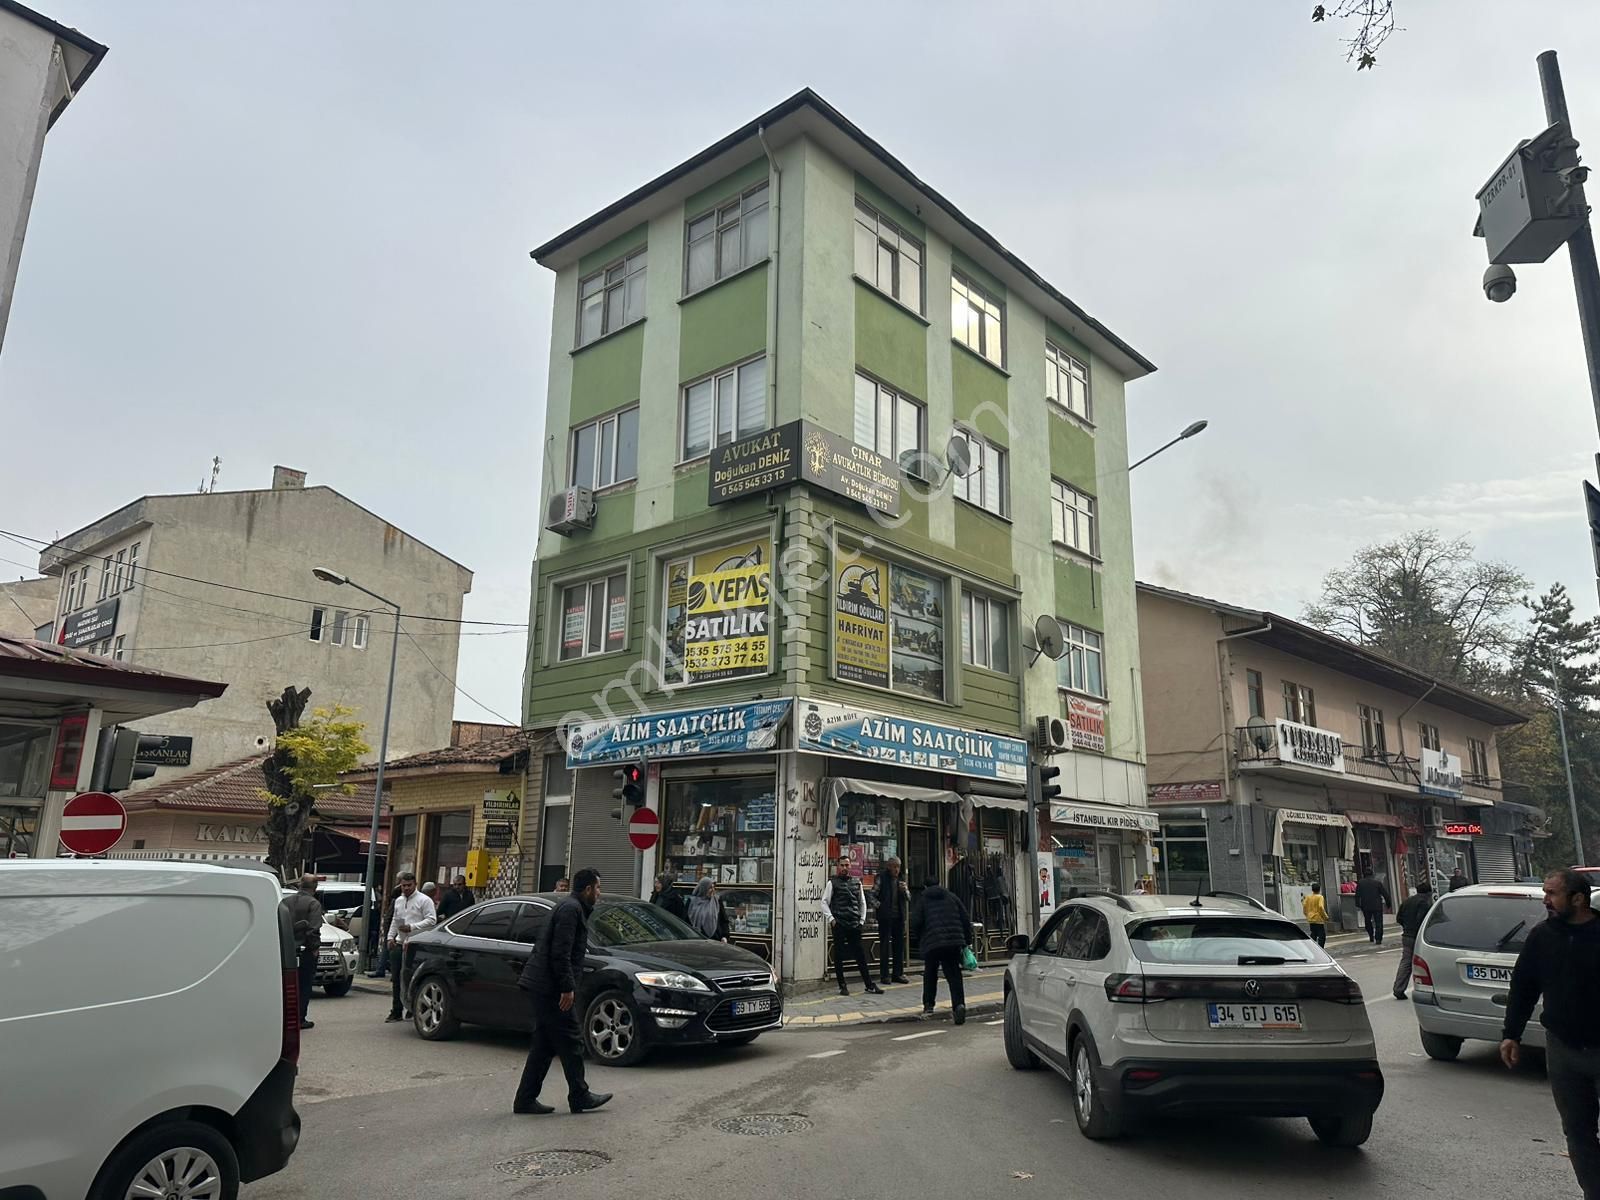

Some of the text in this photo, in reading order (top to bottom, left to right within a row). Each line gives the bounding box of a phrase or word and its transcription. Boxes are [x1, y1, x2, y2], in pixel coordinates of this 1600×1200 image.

[1483, 163, 1517, 207] VZRKPR-01
[721, 432, 781, 464] AVUKAT
[851, 446, 882, 468] ÇINAR
[714, 447, 790, 482] Doğukan DENİZ
[832, 453, 899, 491] AVUKATLIK BÜROSU
[721, 471, 785, 496] 0 545 545 33 13
[851, 479, 875, 495] Doğukan
[876, 488, 893, 503] DENİZ
[709, 572, 770, 604] VEPAŞ
[686, 611, 765, 640] SATILIK
[838, 619, 884, 642] HAFRİYAT
[711, 656, 730, 667] 373
[734, 654, 747, 664] 77
[750, 653, 764, 663] 43
[712, 644, 731, 655] 575
[735, 642, 748, 652] 34
[751, 641, 765, 650] 55
[611, 719, 650, 743] AZİM
[656, 707, 746, 738] SAATÇİLİK
[1070, 713, 1105, 737] SATILIK
[860, 717, 994, 758] AZİM SAATÇİLİK
[1073, 811, 1106, 825] İSTANBUL
[1107, 817, 1118, 827] KIR
[1120, 817, 1140, 828] PİDESİ
[799, 926, 819, 942] ÇEKİLİR
[1473, 967, 1487, 978] 35
[748, 1001, 757, 1011] TY
[1218, 1006, 1297, 1022] 34 GTJ 615
